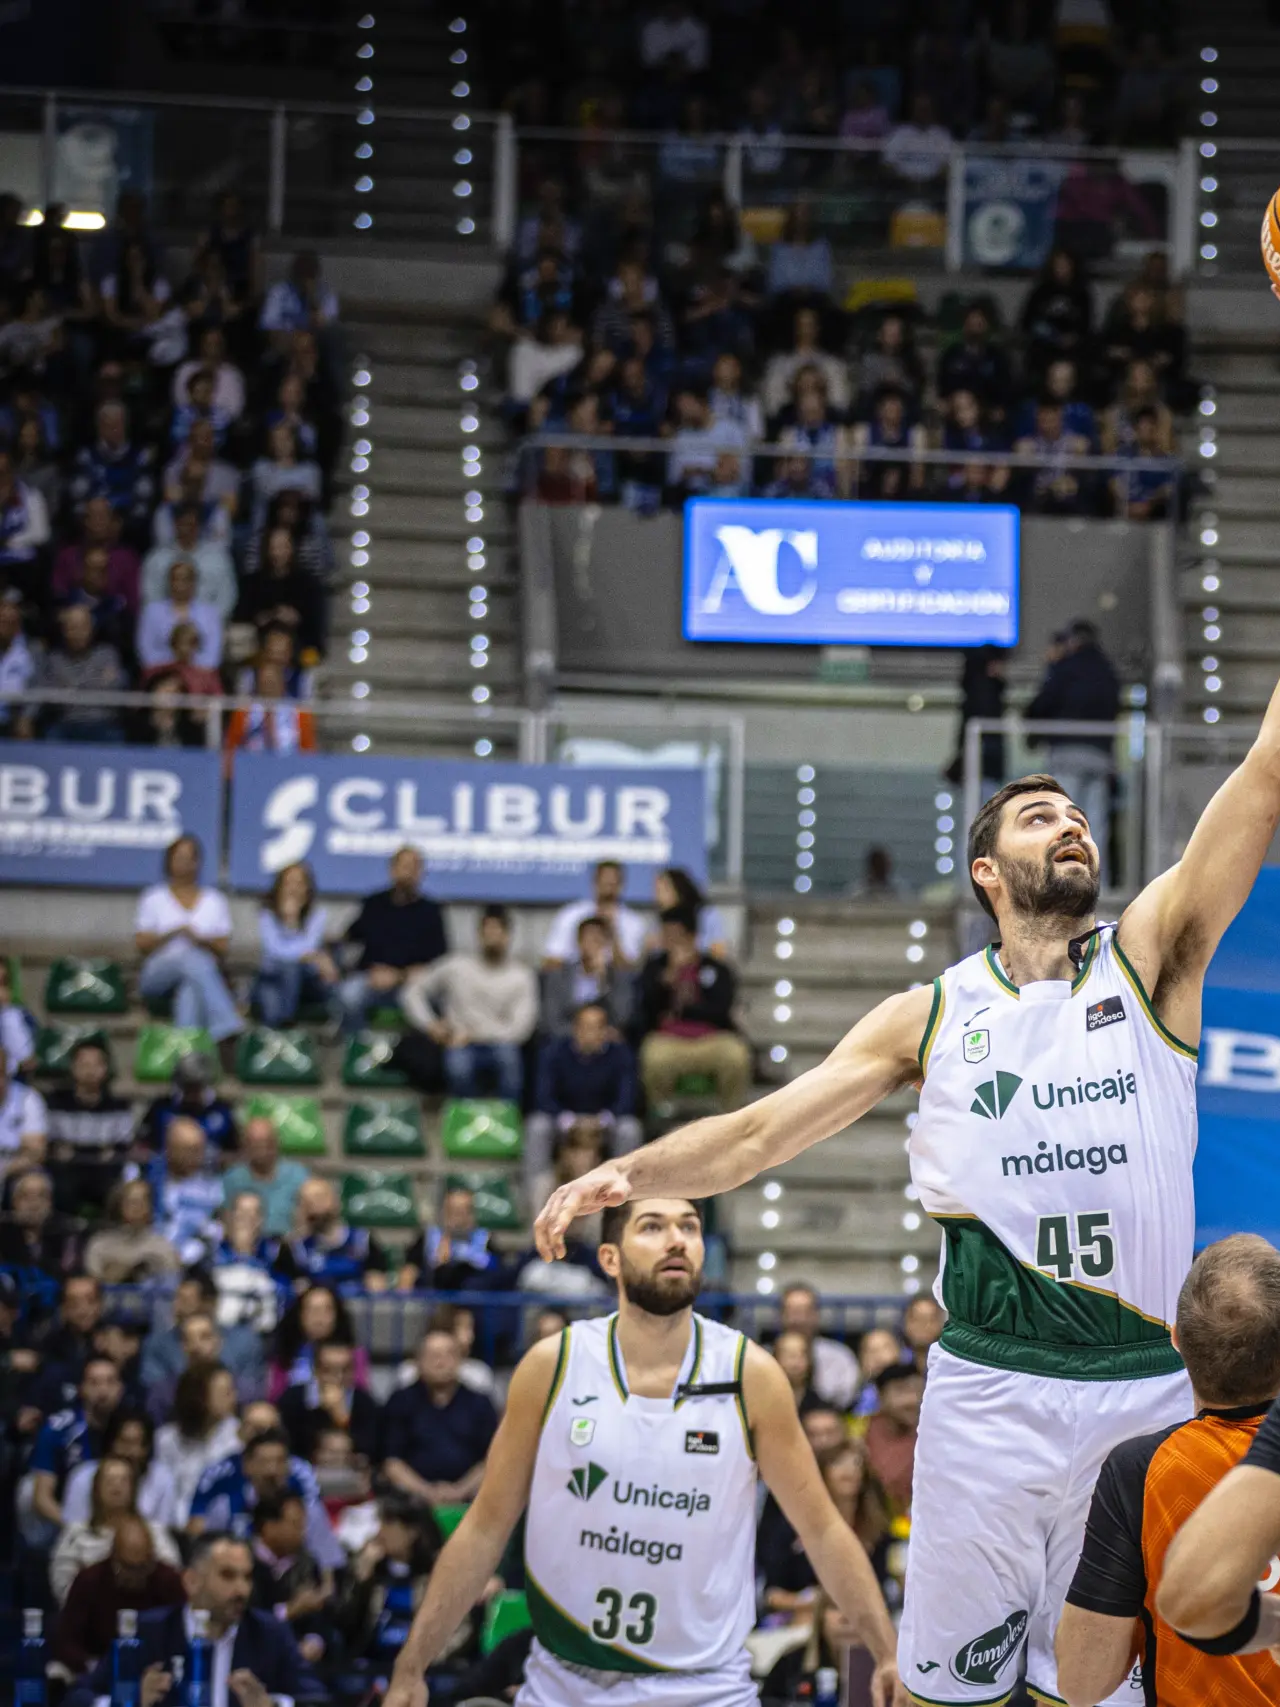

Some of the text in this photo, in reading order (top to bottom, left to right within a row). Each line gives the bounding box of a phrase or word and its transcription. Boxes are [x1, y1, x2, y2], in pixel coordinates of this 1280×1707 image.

[328, 777, 671, 838] CLIBUR
[1032, 1069, 1136, 1110] Unicaja
[1036, 1209, 1116, 1282] 45
[612, 1480, 712, 1518] Unicaja
[592, 1586, 658, 1646] 33
